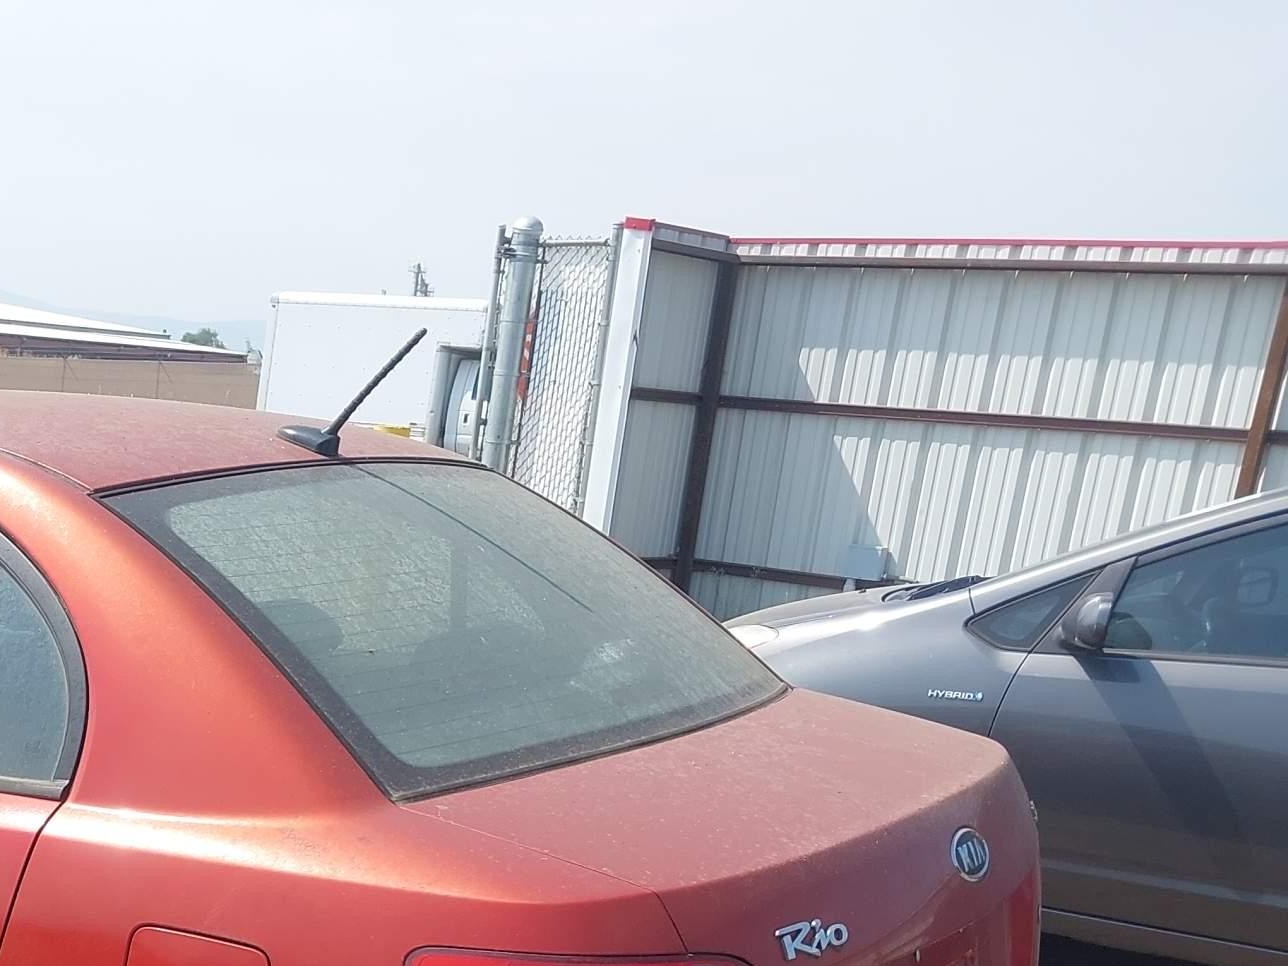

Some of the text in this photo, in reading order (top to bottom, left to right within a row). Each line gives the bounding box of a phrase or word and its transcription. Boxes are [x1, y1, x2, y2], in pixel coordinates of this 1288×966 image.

[927, 688, 974, 701] HYBRID
[956, 838, 986, 872] KIA
[775, 918, 848, 960] Rio
